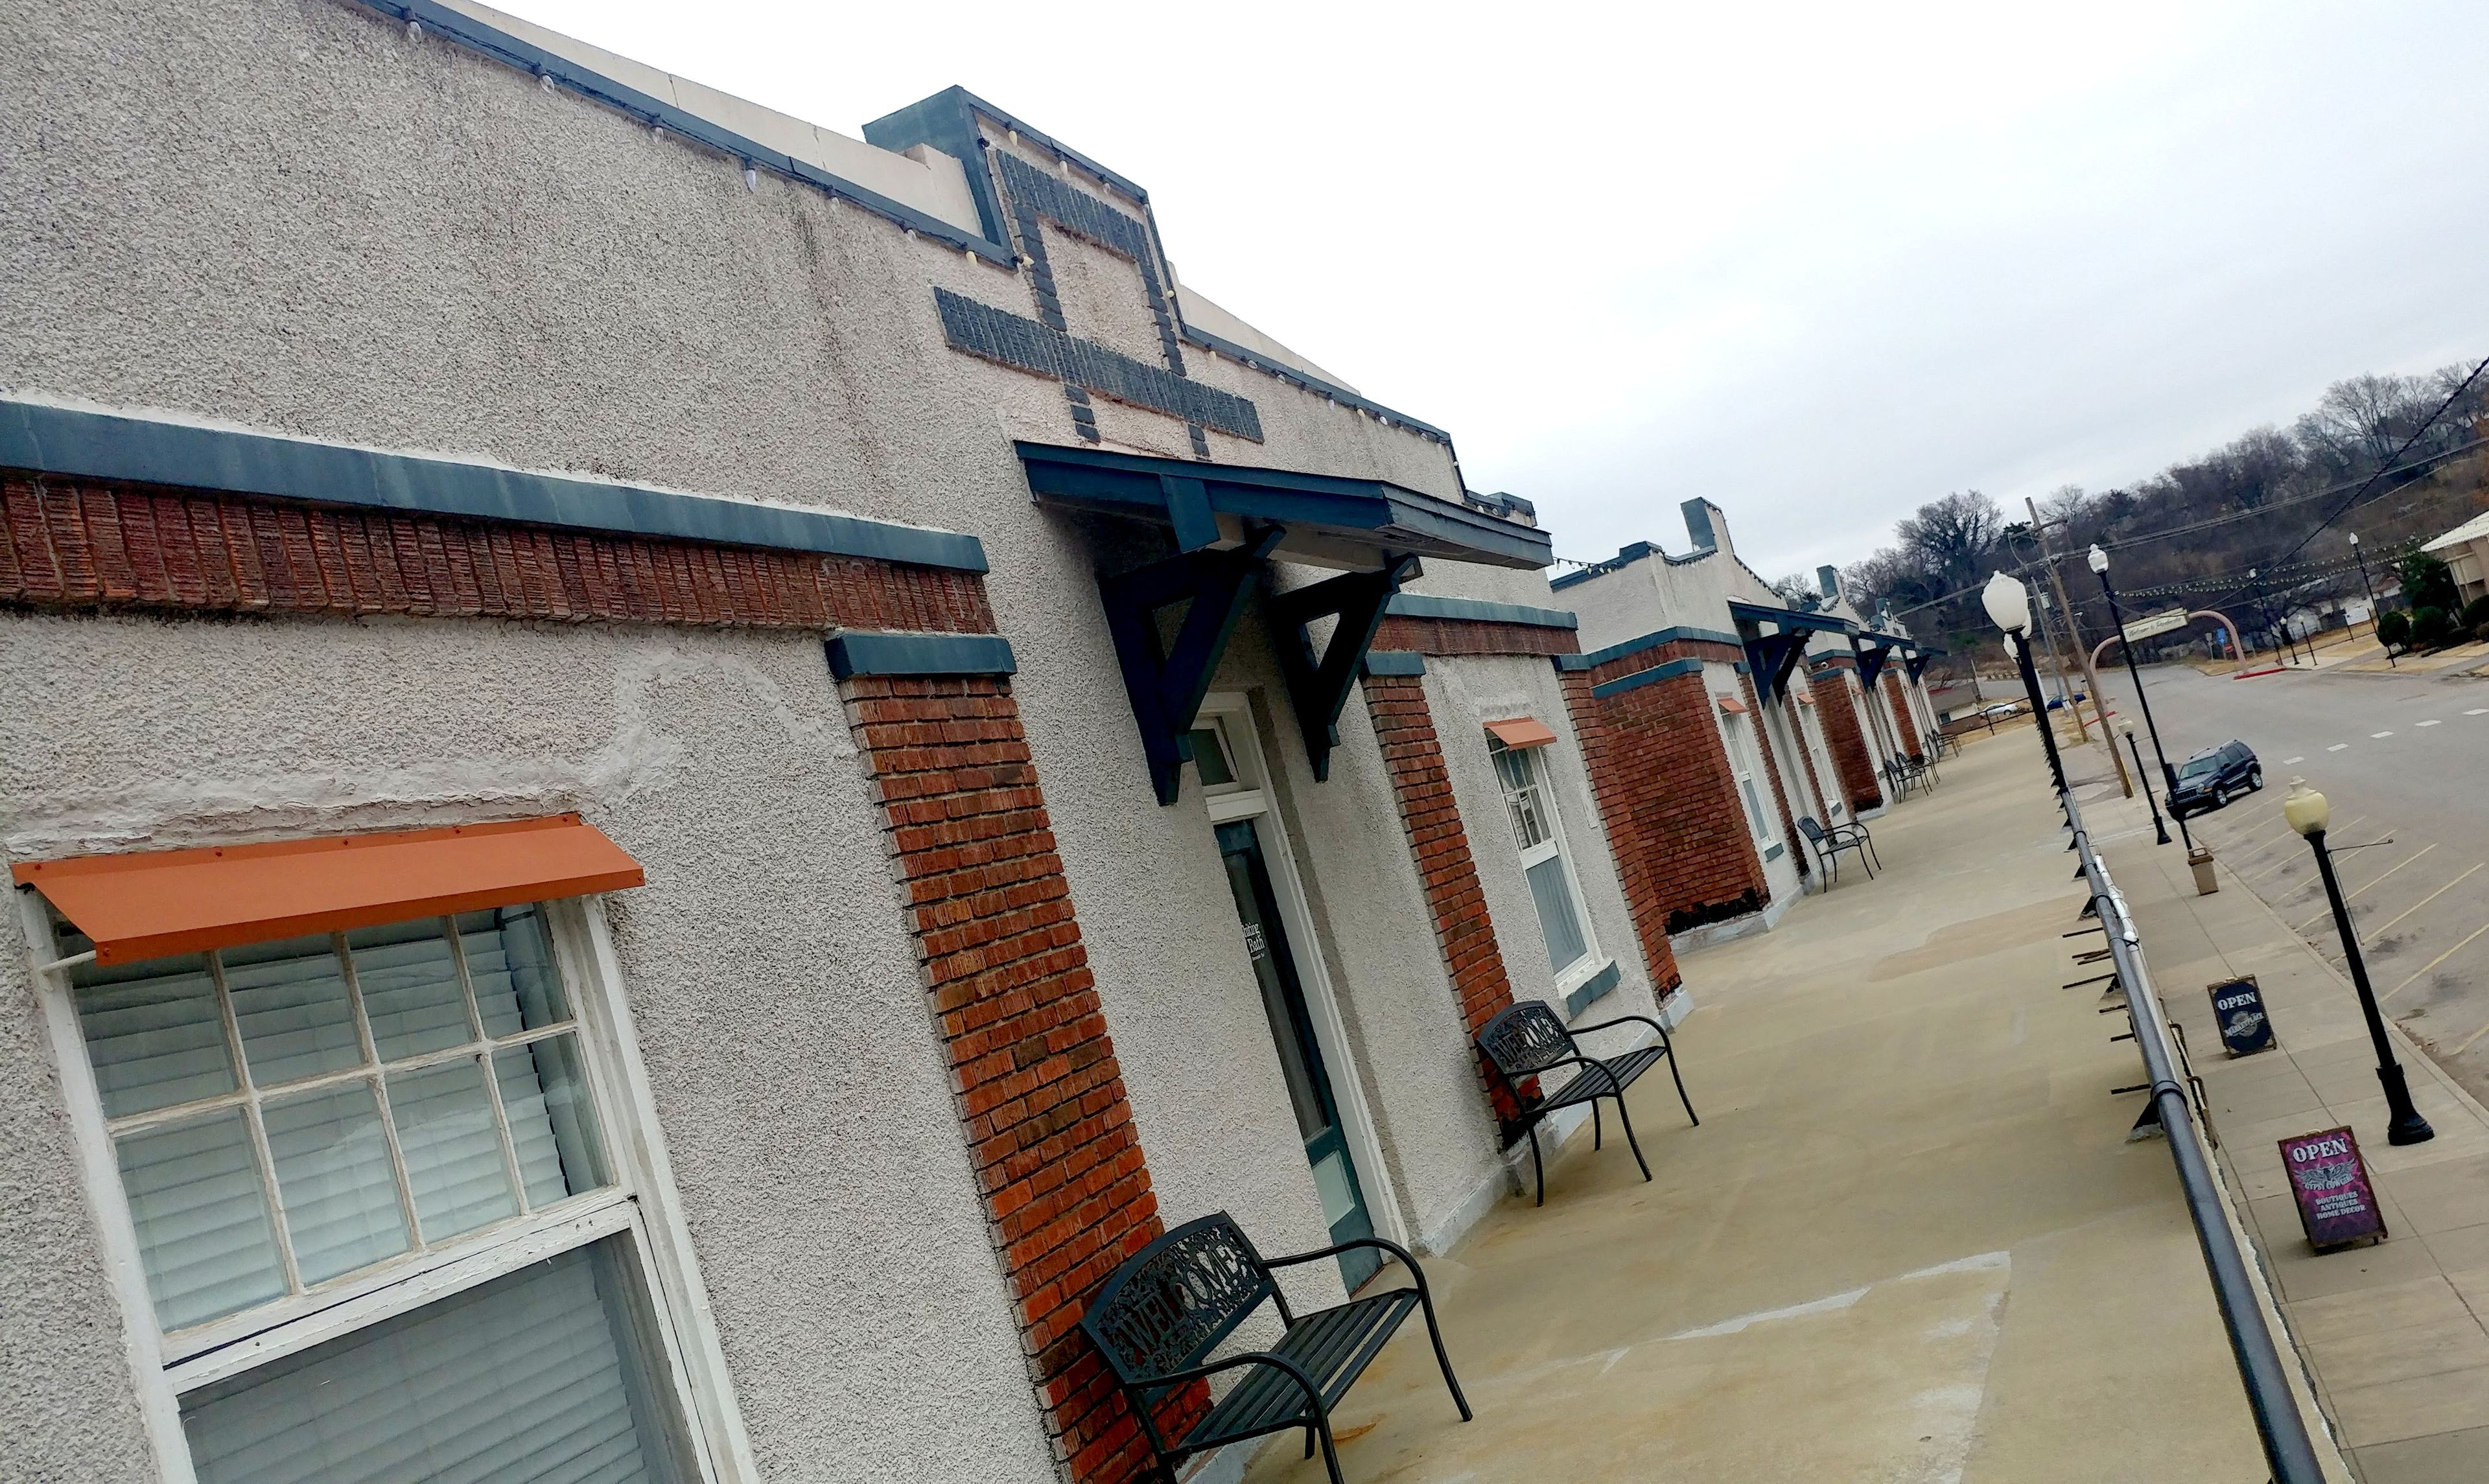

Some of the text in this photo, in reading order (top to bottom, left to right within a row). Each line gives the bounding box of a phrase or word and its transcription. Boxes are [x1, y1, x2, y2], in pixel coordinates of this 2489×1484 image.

[1247, 936, 1265, 953] Bath
[2217, 992, 2258, 1010] OPEN
[2225, 1012, 2265, 1038] MARKETPLACE
[1493, 1015, 1557, 1066] WELCOME
[2293, 1138, 2348, 1163] OPEN
[2304, 1180, 2326, 1190] GYPSY
[2315, 1191, 2358, 1205] BOUTIQUES
[2320, 1199, 2358, 1212] ANTIQUES
[2316, 1205, 2366, 1220] HOME DECOR
[1116, 1240, 1241, 1356] WELCOME
